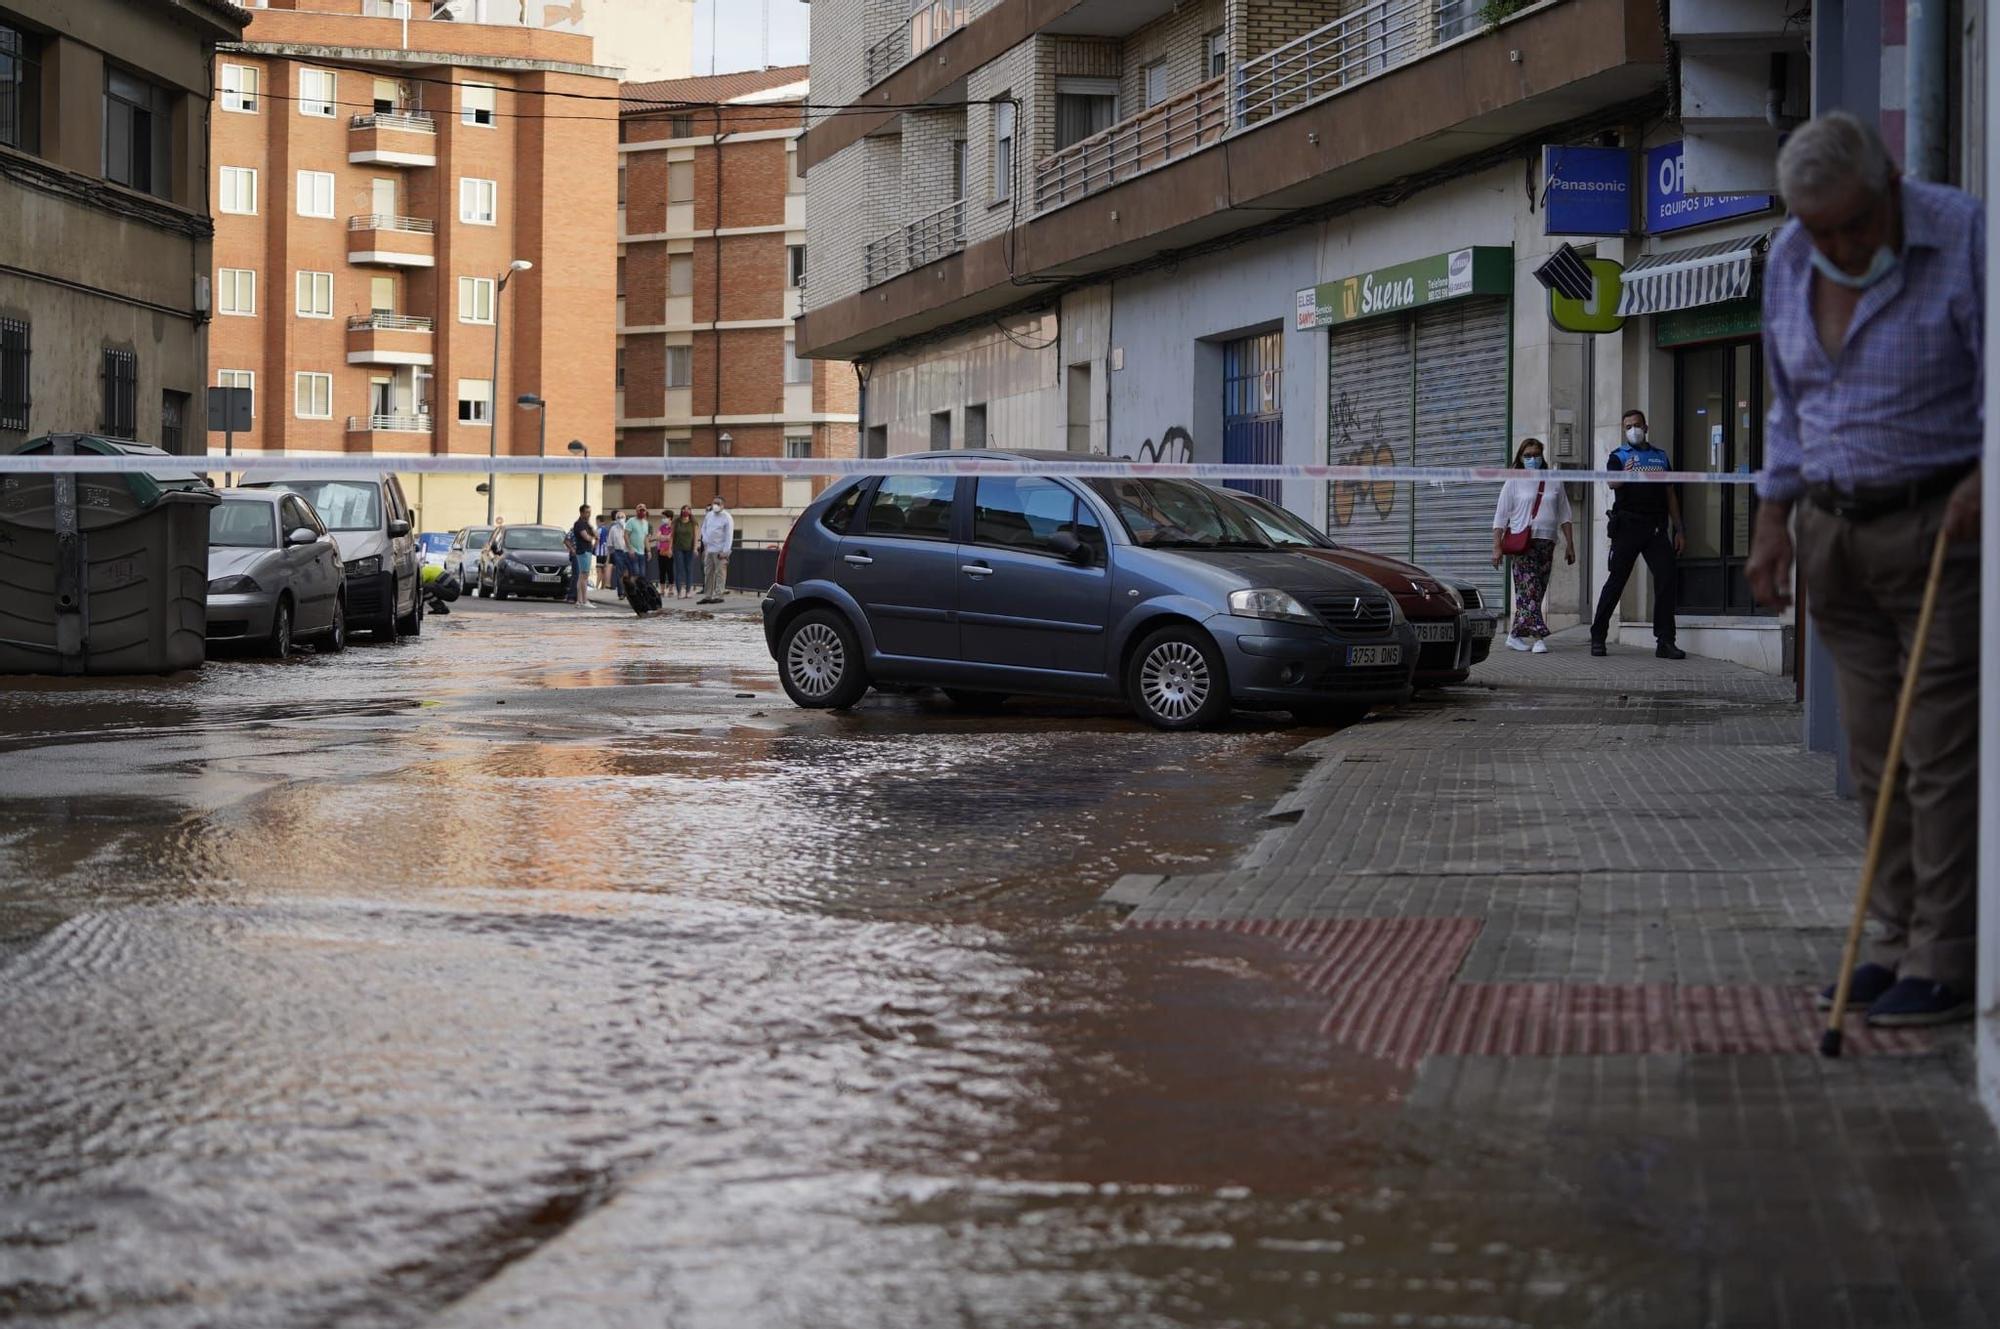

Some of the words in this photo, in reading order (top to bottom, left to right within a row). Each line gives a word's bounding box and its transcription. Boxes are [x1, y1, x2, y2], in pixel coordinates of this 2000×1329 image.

[1552, 178, 1627, 193] Panasonic
[1660, 197, 1699, 218] EQUIPOS
[1362, 273, 1414, 314] Suena
[1352, 646, 1375, 664] 3753
